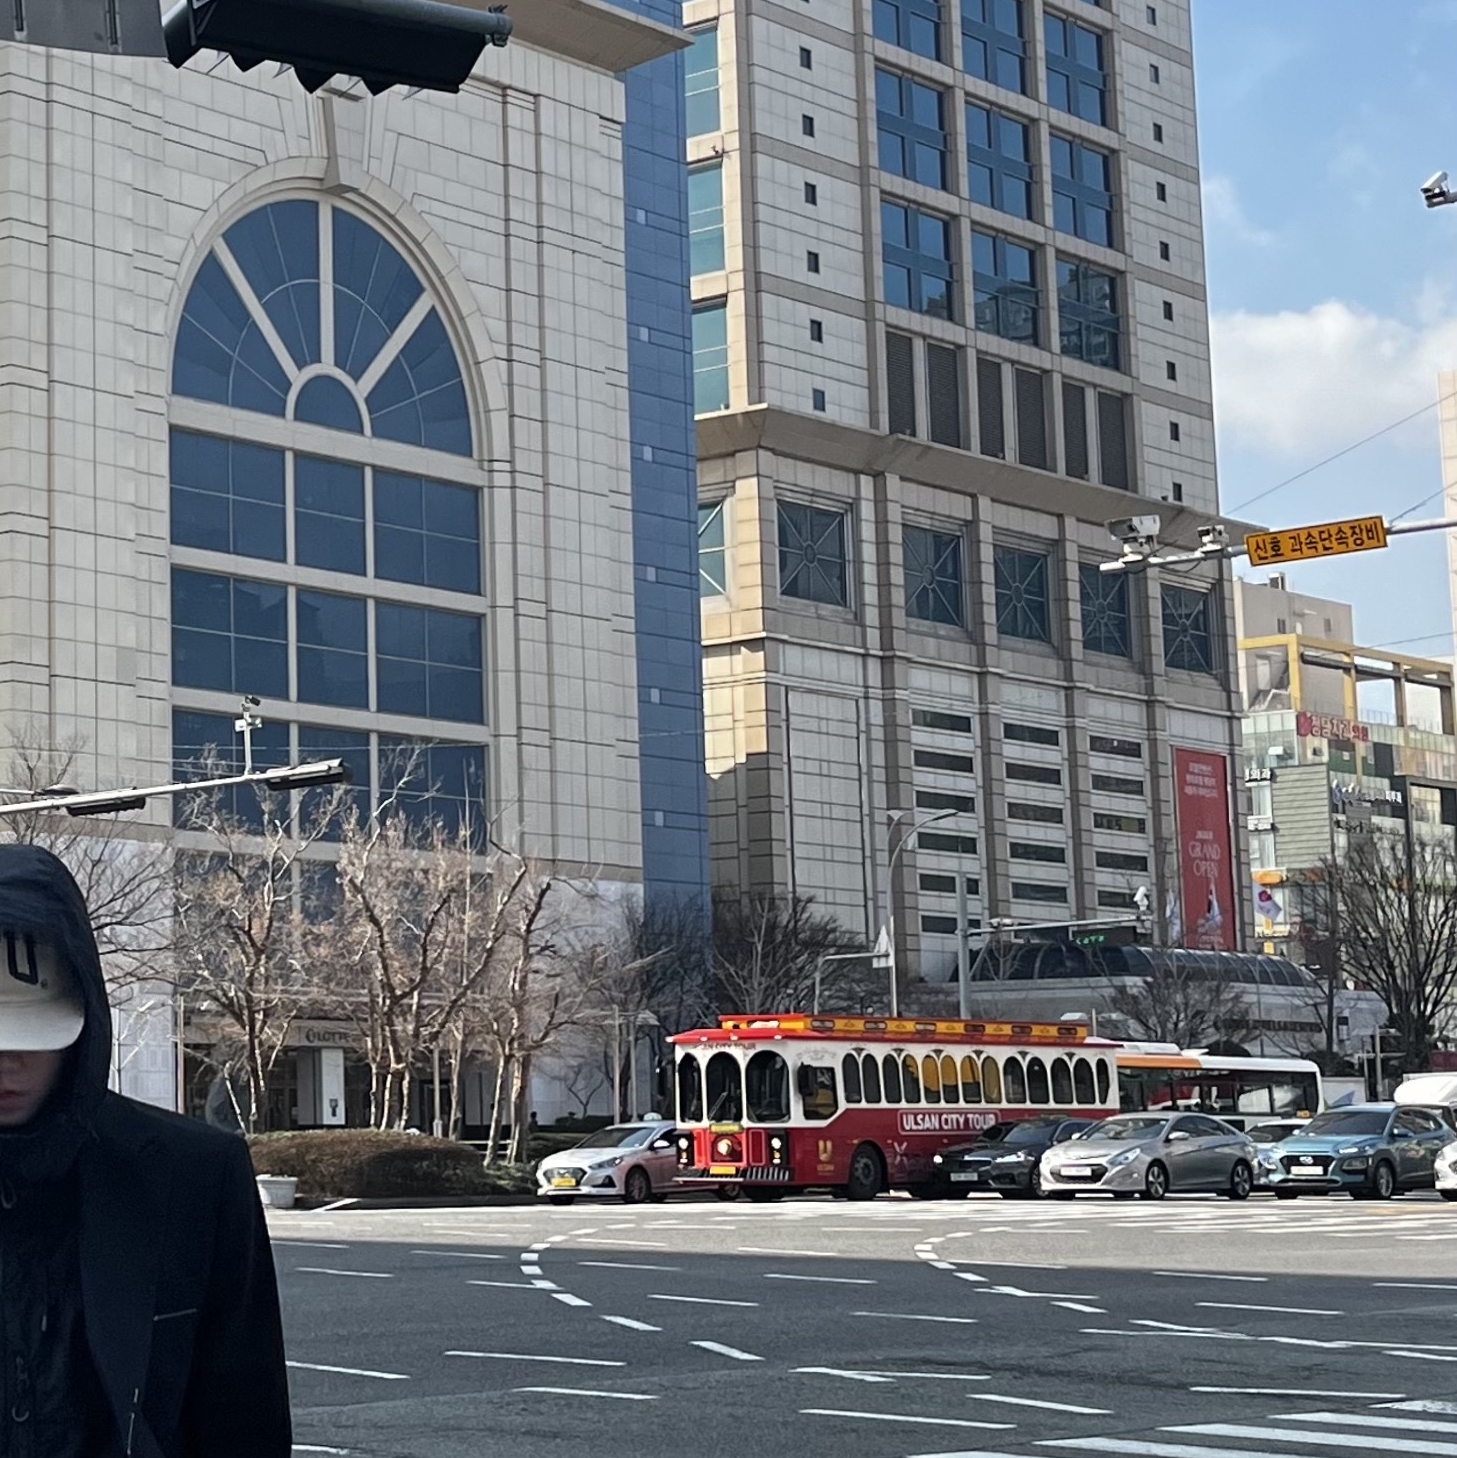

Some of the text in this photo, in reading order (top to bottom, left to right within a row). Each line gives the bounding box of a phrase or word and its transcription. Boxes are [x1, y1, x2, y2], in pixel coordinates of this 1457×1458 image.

[1254, 521, 1381, 561] 신호 과속단속장비
[1188, 841, 1221, 860] GRAND
[1193, 859, 1219, 878] OPEN
[902, 1113, 997, 1131] ULSAN CITY TOUR
